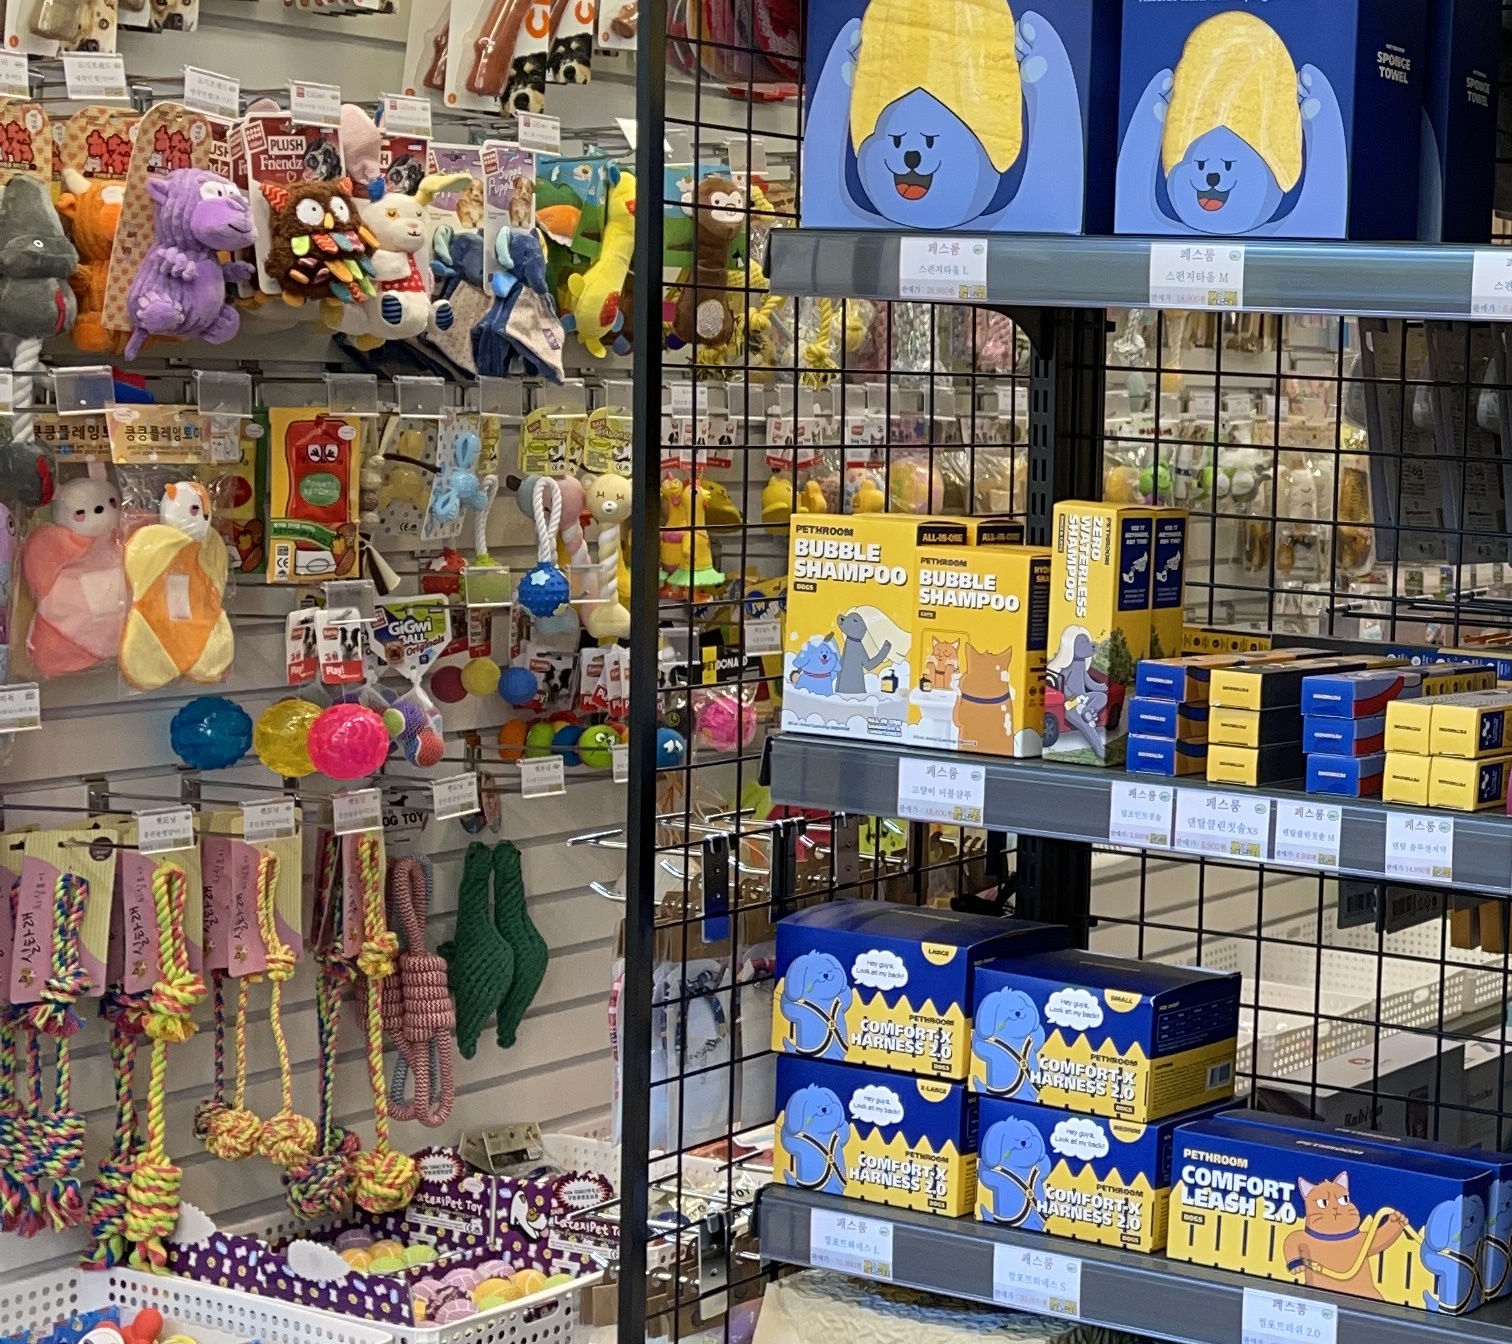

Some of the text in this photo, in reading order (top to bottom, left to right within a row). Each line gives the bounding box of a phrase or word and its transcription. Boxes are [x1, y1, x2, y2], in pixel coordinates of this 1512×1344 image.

[1377, 51, 1411, 71] SPONGE
[1379, 67, 1408, 84] TOWEL
[270, 138, 304, 152] PLUSH
[260, 153, 303, 171] Friendz
[928, 242, 961, 256] 페스룸
[1180, 248, 1216, 262] 페스룸
[1219, 272, 1229, 283] M
[796, 525, 854, 537] PETHROOM
[1091, 516, 1103, 561] ZERO
[794, 538, 881, 562] BUBBLE
[1065, 514, 1078, 602] SHAMPOO
[920, 557, 967, 567] PETHROOM
[1076, 515, 1092, 618] WATERLESS
[794, 560, 907, 586] SHAMPOO
[919, 569, 996, 591] BUBBLE
[919, 589, 1020, 612] SHAMPOO
[387, 618, 433, 636] GiGwi
[325, 664, 344, 676] Play!
[926, 765, 958, 780] 페스룸
[1128, 788, 1157, 801] 페스룸
[1206, 796, 1241, 813] 페스룸
[402, 810, 425, 825] TOY
[1294, 808, 1325, 820] 페스룸
[1404, 819, 1436, 832] 페스룸
[909, 1015, 954, 1026] PETHROOM
[860, 1020, 952, 1045] COMFORT-X
[851, 1032, 951, 1060] HARNESS 2.0
[1091, 1054, 1138, 1067] PETHROOM
[1039, 1058, 1136, 1085] COMFORT-X
[1030, 1071, 1106, 1096] HARNESS
[1110, 1084, 1135, 1101] 2.0
[905, 1151, 949, 1163] PETHROOM
[1184, 1148, 1248, 1168] PETHROOM
[858, 1154, 947, 1182] COMFORT-X
[849, 1167, 947, 1197] HARNESS 2.0
[1097, 1184, 1144, 1197] PETHROOM
[1182, 1164, 1295, 1202] COMFORT
[1046, 1187, 1142, 1216] COMFORT-X
[1181, 1186, 1297, 1225] LEASH 2.0
[1036, 1200, 1141, 1231] HARNESS 2.0
[836, 1217, 868, 1234] 페스룸
[1273, 1299, 1307, 1316] 페스룸
[1306, 1328, 1320, 1338] 2.0
